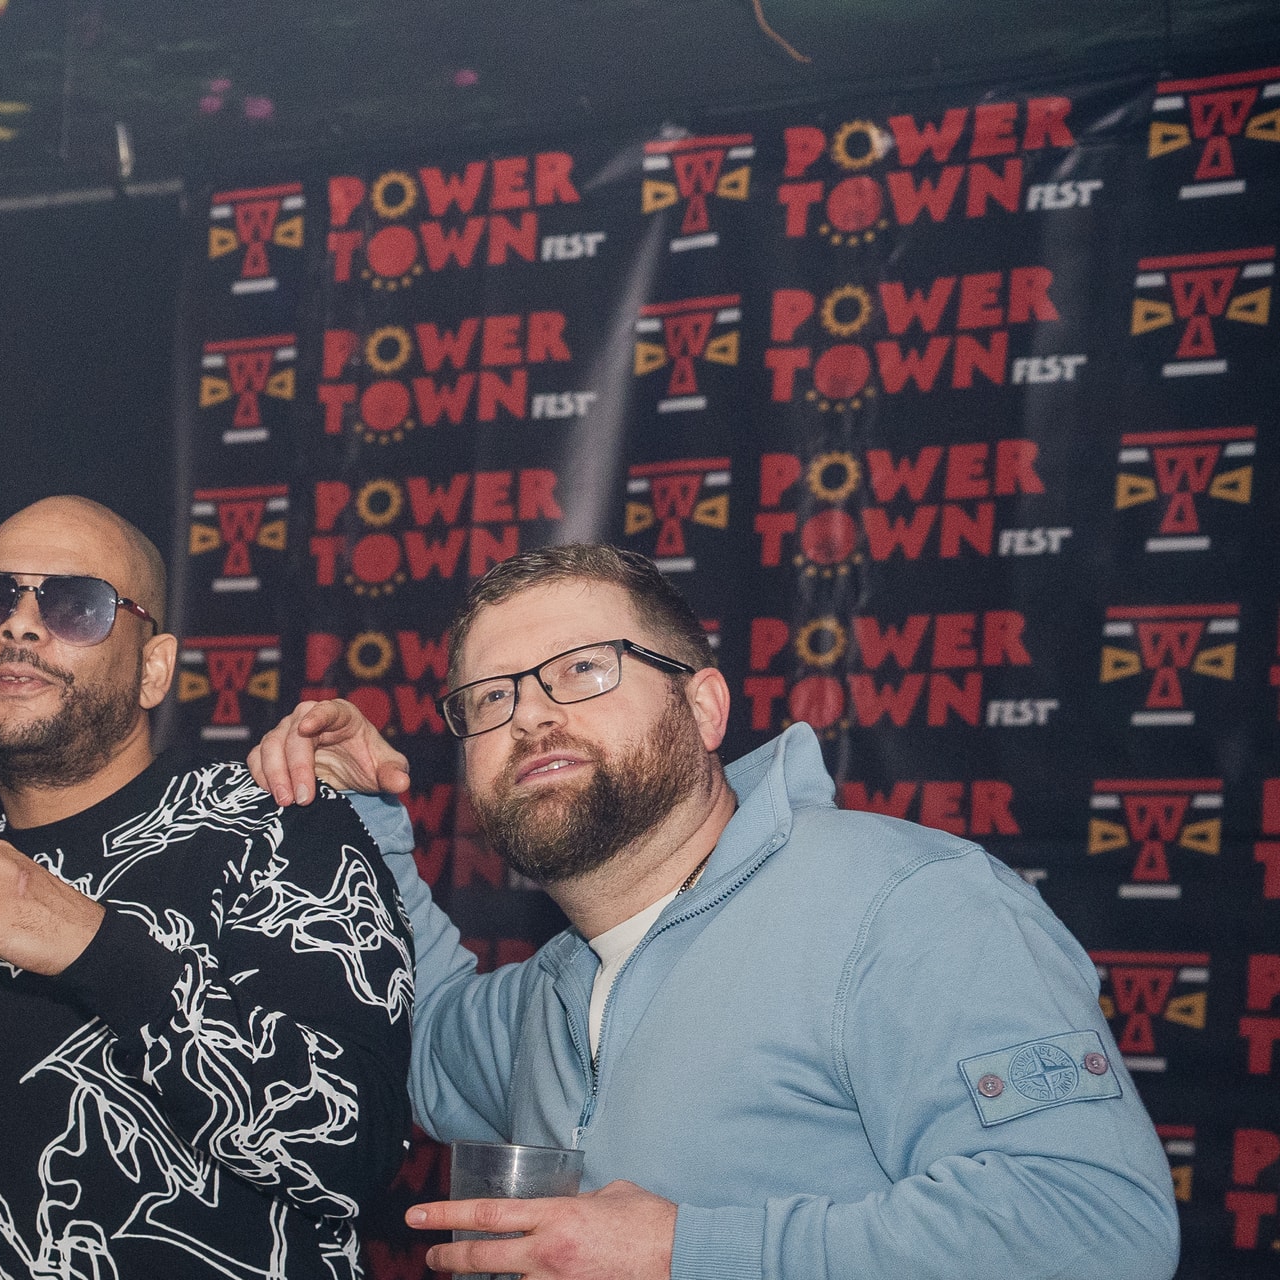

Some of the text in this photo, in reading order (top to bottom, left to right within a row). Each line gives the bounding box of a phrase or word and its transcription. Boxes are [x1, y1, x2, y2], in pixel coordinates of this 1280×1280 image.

[783, 96, 1075, 178] POWER
[328, 152, 581, 226] POWER
[777, 158, 1104, 237] TOWN FEST
[327, 211, 606, 282] TOWN FEST
[770, 266, 1059, 342] POWER
[323, 310, 572, 378] POWER
[764, 331, 1087, 402] TOWN FEST
[317, 368, 598, 434] TOWN FEST
[314, 468, 562, 531] POWER
[759, 438, 1045, 506] POWER
[754, 502, 1074, 566] TOWN FEST
[750, 610, 1032, 671] POWER
[744, 671, 1059, 730] TOWN FEST
